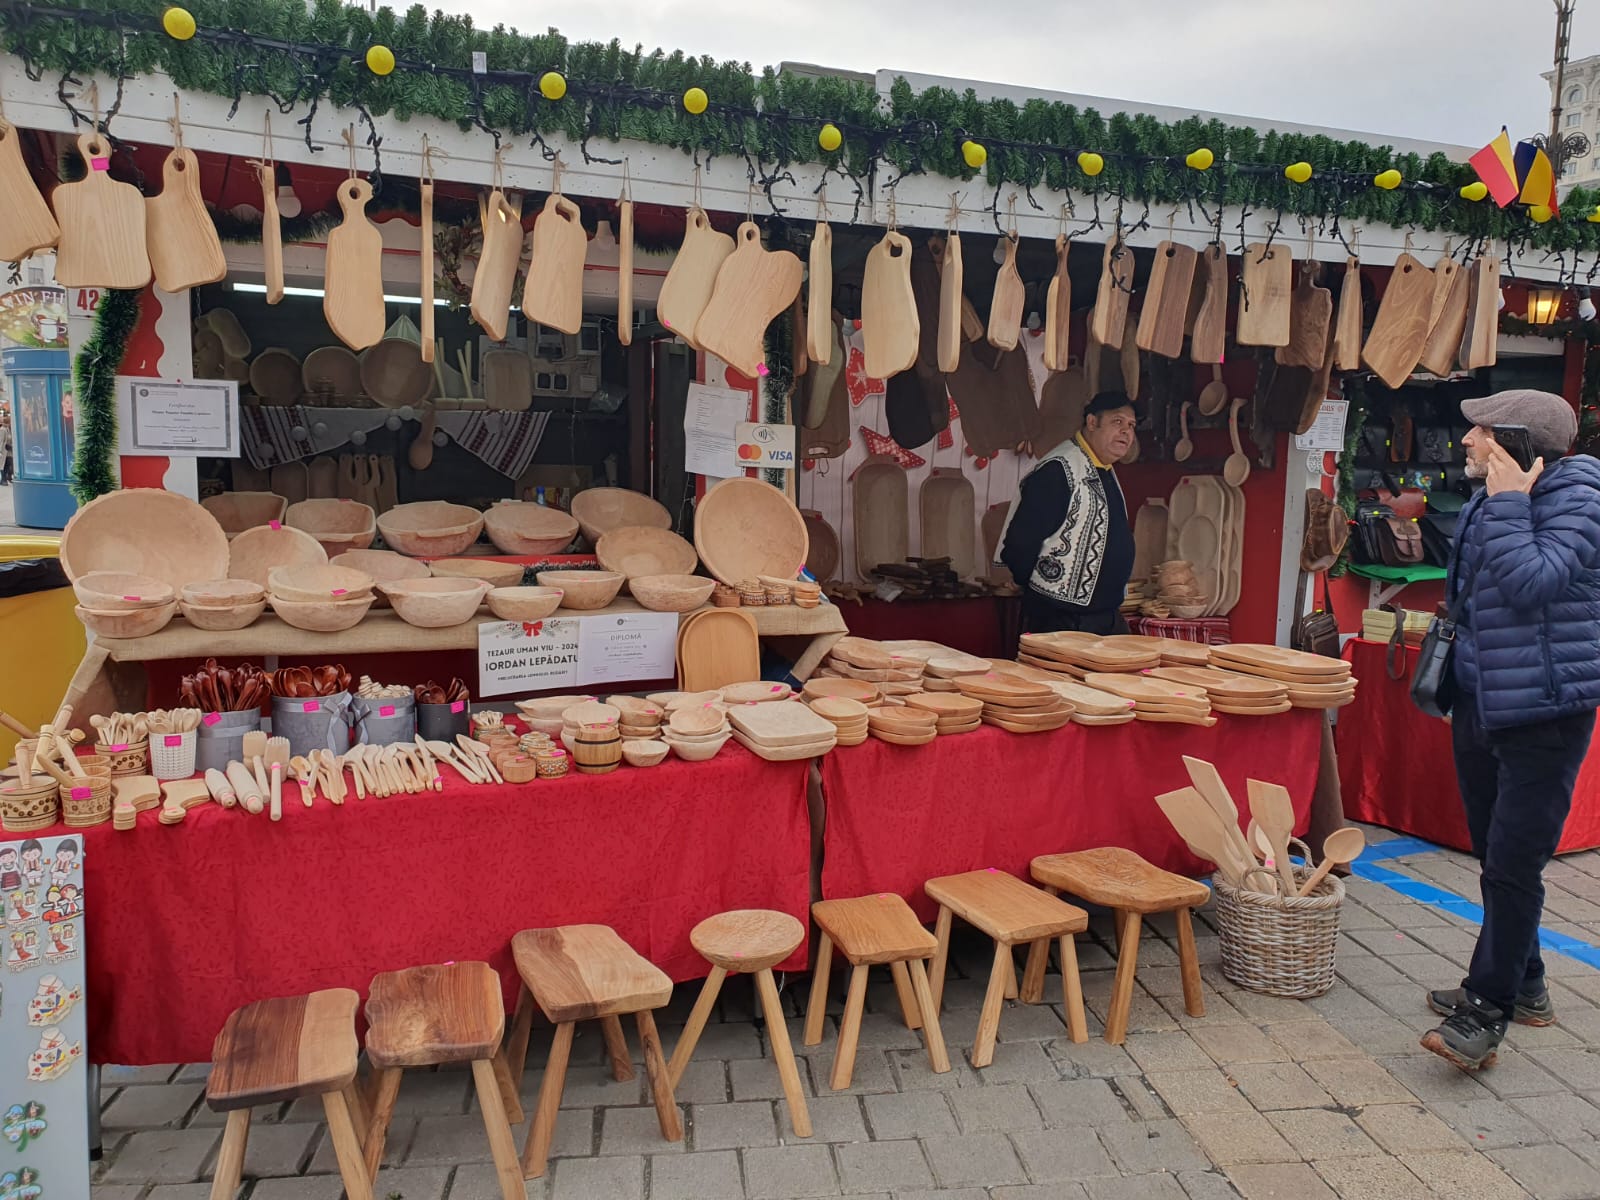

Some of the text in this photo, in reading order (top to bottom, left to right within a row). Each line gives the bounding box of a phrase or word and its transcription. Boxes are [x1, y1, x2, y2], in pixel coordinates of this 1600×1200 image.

[77, 289, 100, 311] 42
[768, 450, 793, 461] VISA
[610, 633, 642, 641] DIPLOMĂ
[487, 648, 515, 657] TEZAUR
[516, 645, 539, 654] UMAN
[485, 659, 526, 671] IORDAN
